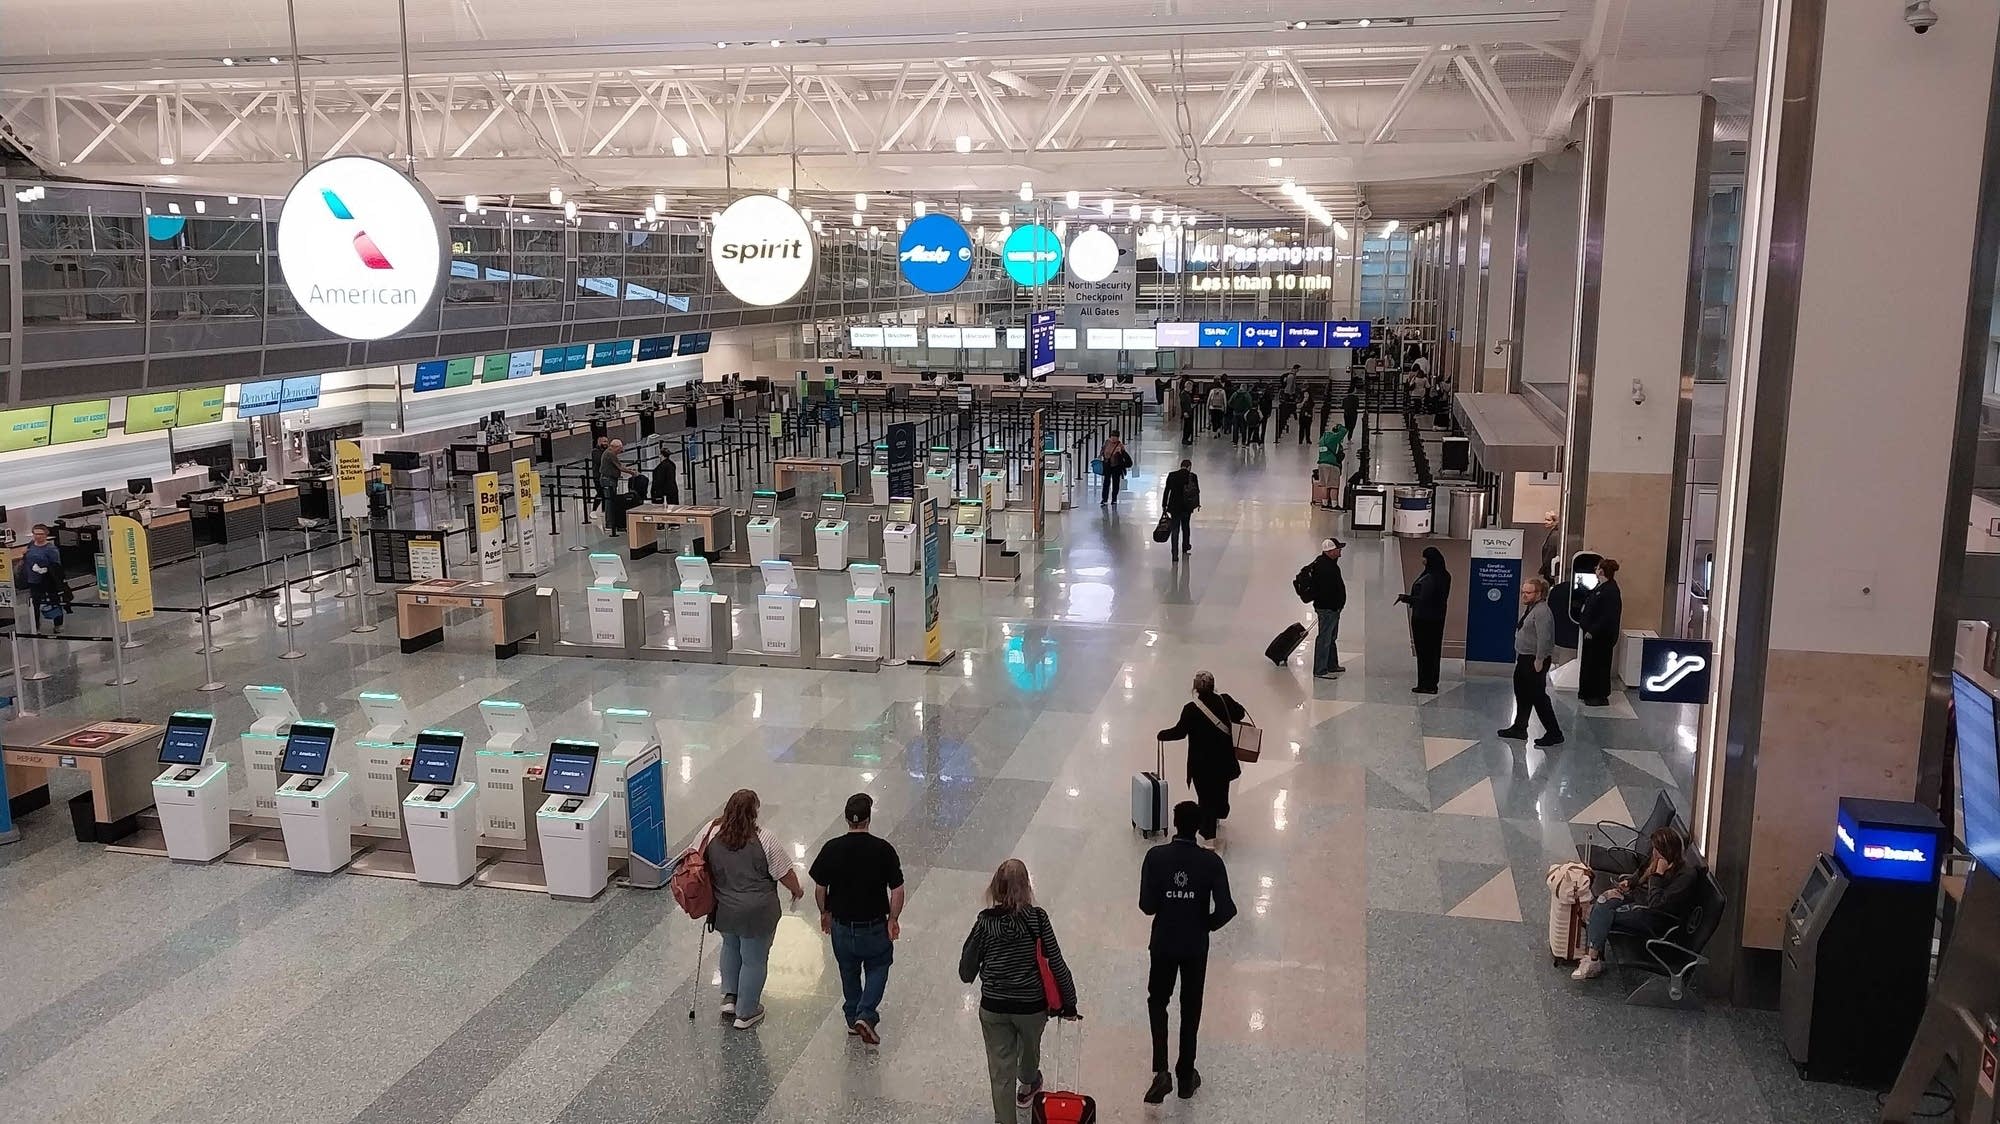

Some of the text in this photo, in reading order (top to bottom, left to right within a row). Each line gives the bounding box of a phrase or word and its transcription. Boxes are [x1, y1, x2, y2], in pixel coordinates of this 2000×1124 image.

[721, 239, 802, 264] spirit
[1191, 244, 1333, 265] All Passengers
[1068, 281, 1132, 292] North Security
[1191, 274, 1332, 290] Less than 10 min
[309, 284, 416, 304] American
[1076, 292, 1124, 302] Checkpoint
[1080, 307, 1120, 316] All Gates
[127, 528, 139, 585] PRIORITY CHECK-IN
[1166, 891, 1195, 899] CLEAR
